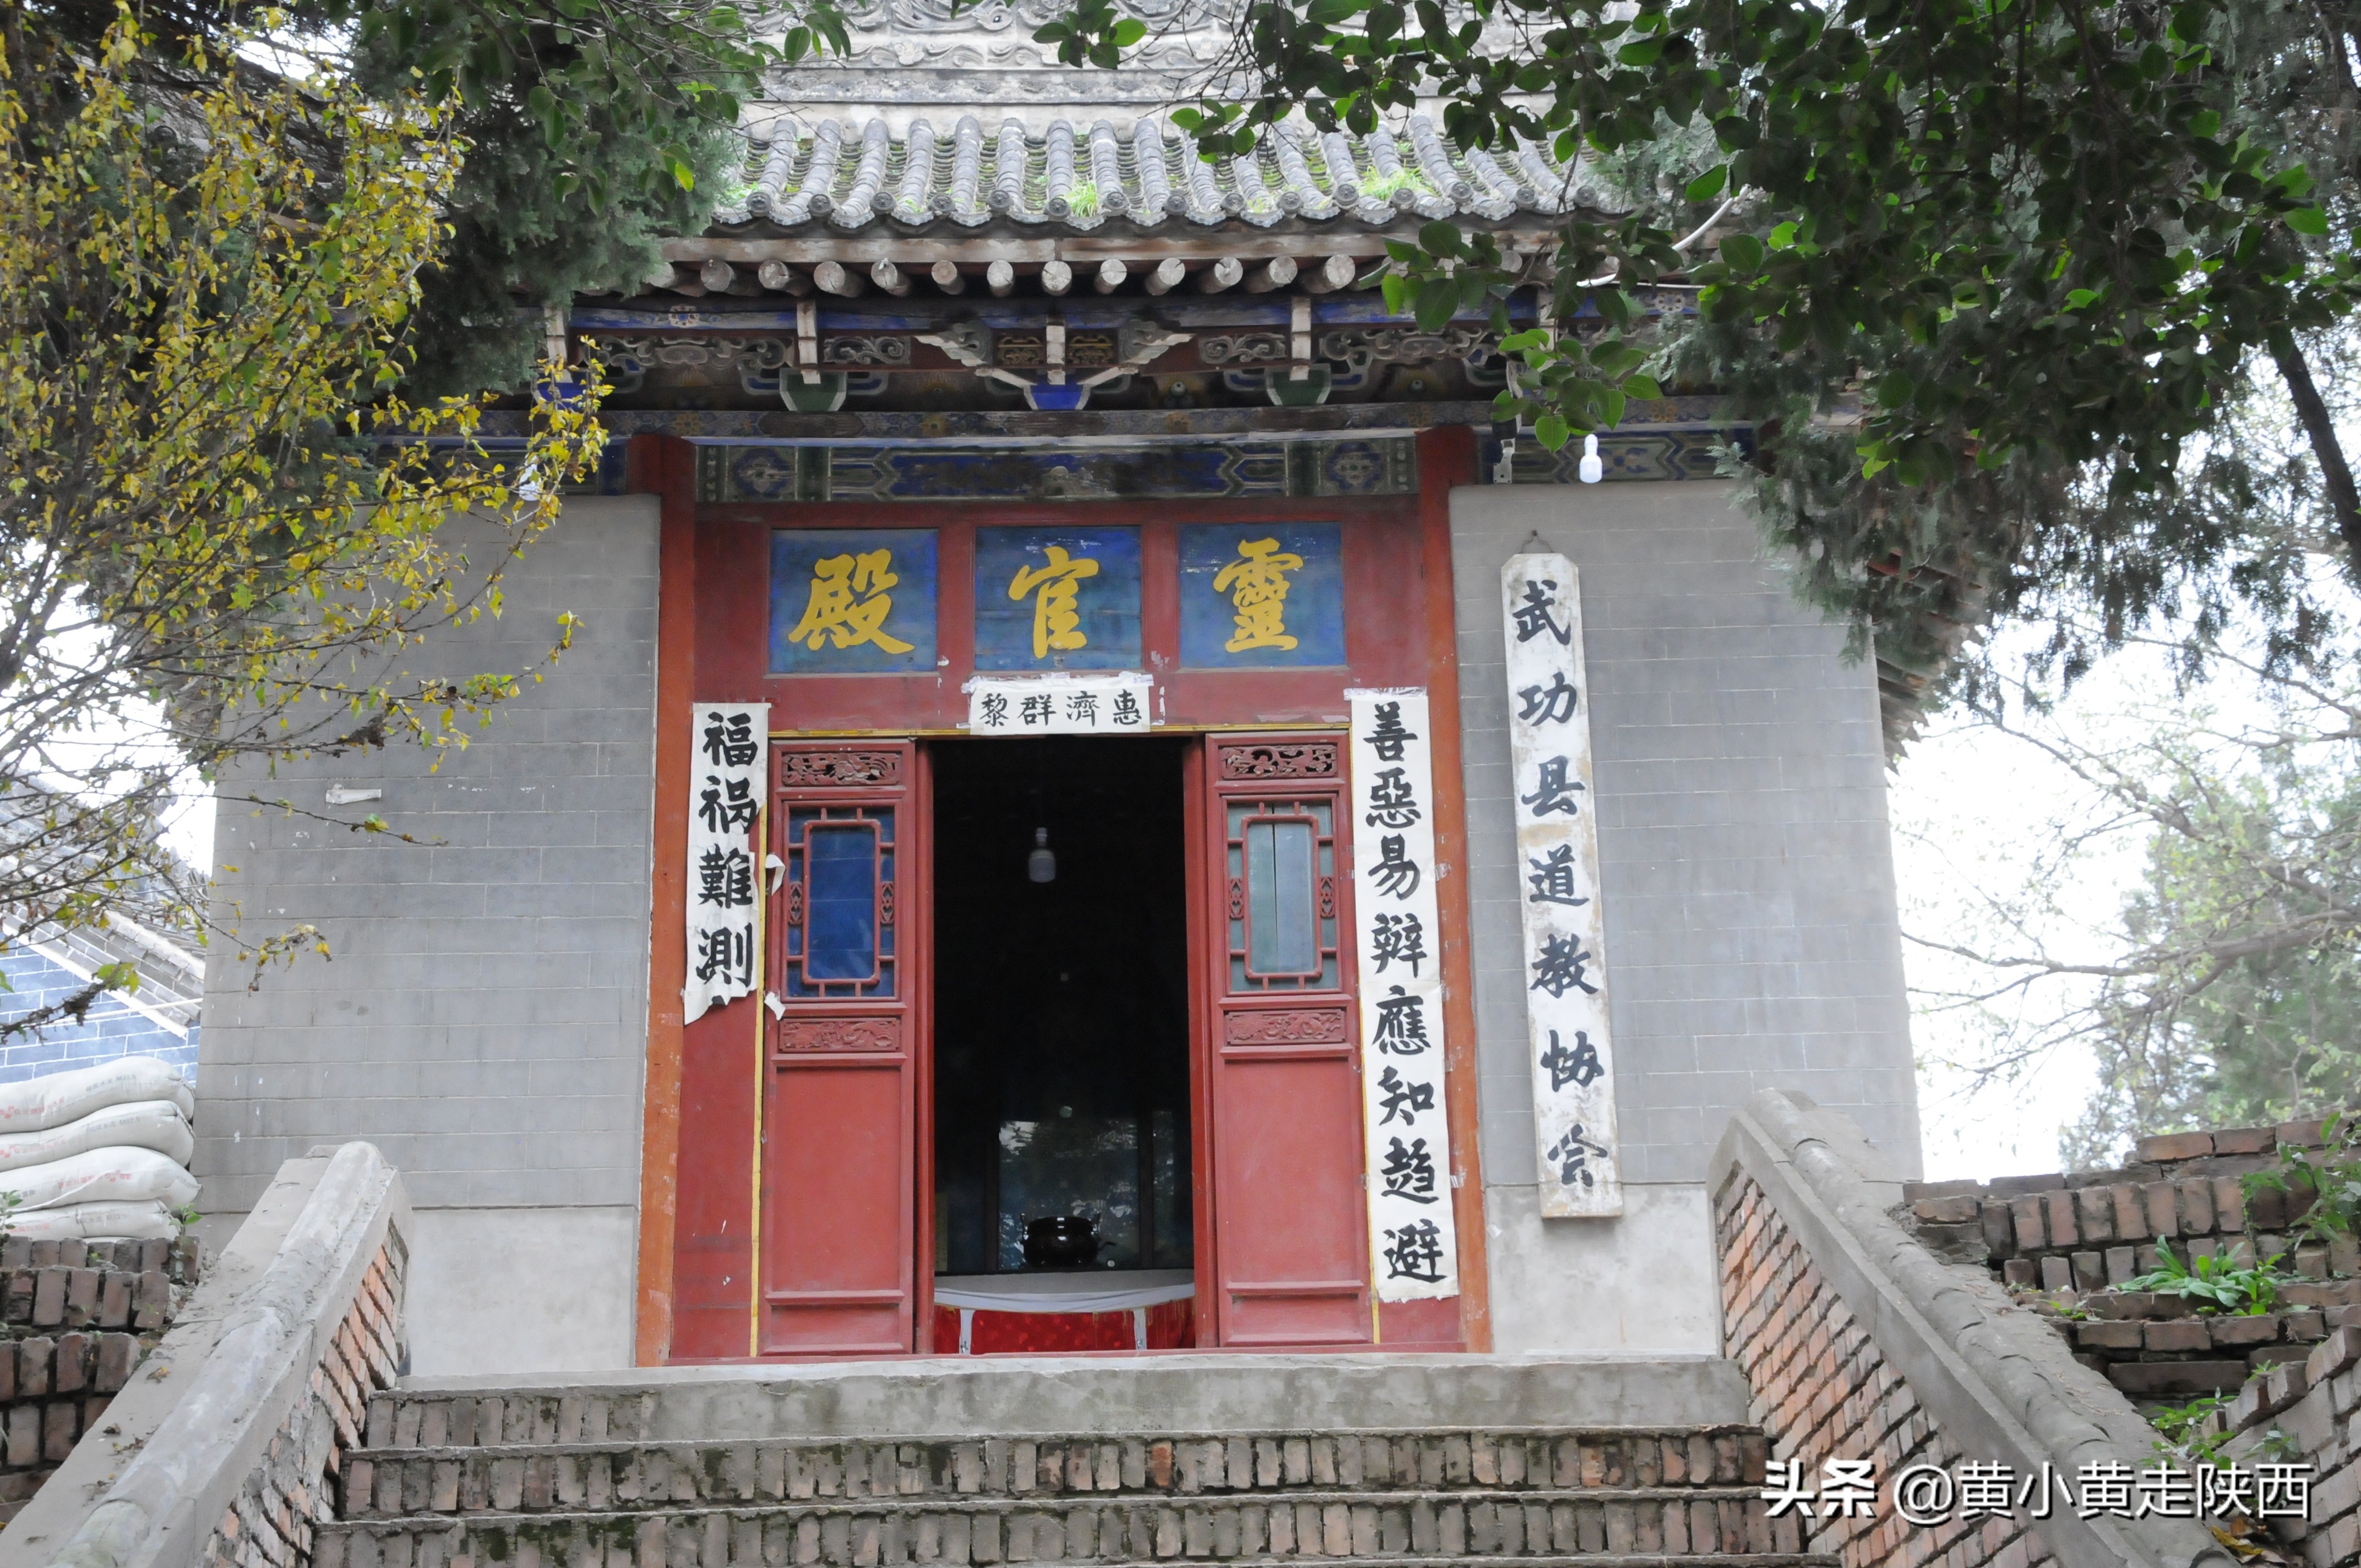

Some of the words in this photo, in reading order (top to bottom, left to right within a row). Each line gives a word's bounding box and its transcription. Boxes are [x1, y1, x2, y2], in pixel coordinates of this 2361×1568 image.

[1513, 580, 1607, 1186] 武功县道教协会
